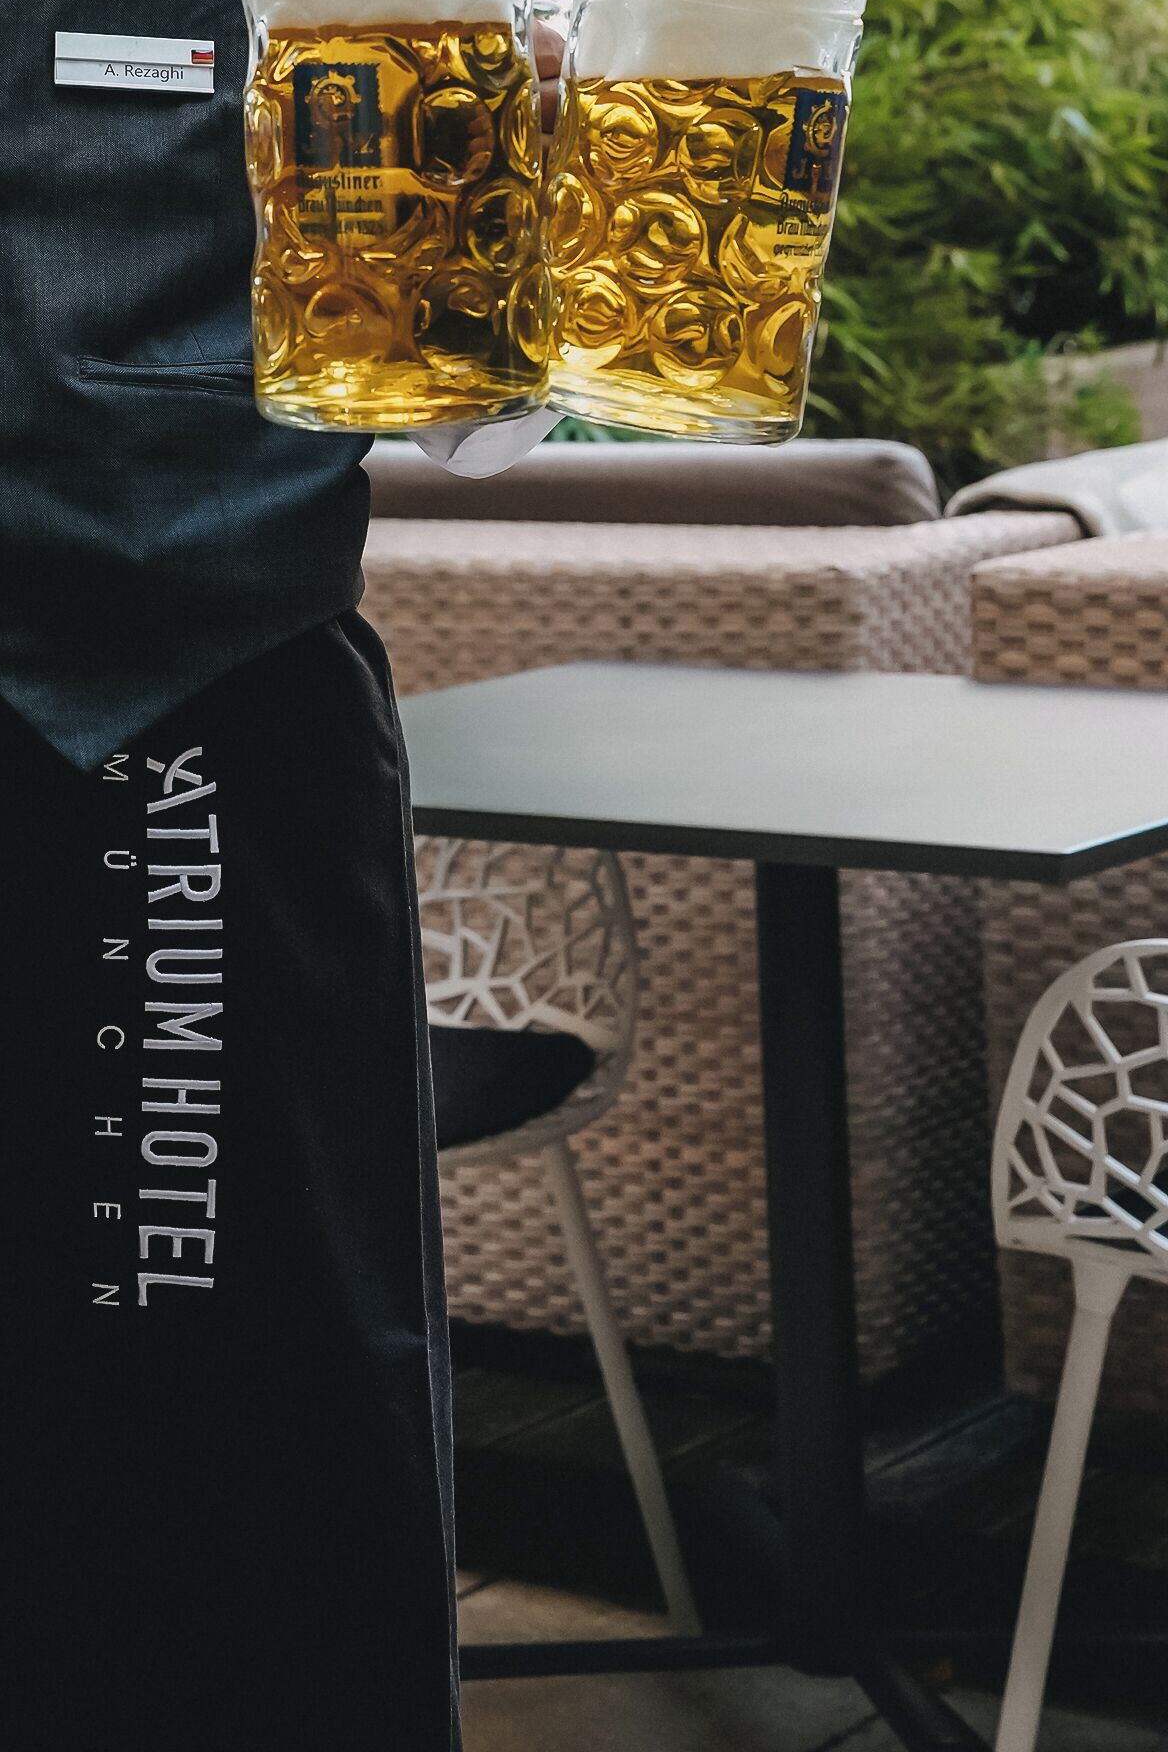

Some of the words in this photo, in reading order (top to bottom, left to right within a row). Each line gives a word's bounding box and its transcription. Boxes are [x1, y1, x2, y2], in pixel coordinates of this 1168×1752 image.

[104, 63, 119, 77] A.
[124, 64, 184, 83] Rezaghi
[91, 753, 137, 1306] MÜNCHEN
[143, 745, 224, 1051] ATRIUM
[136, 1076, 222, 1307] HOTEL
